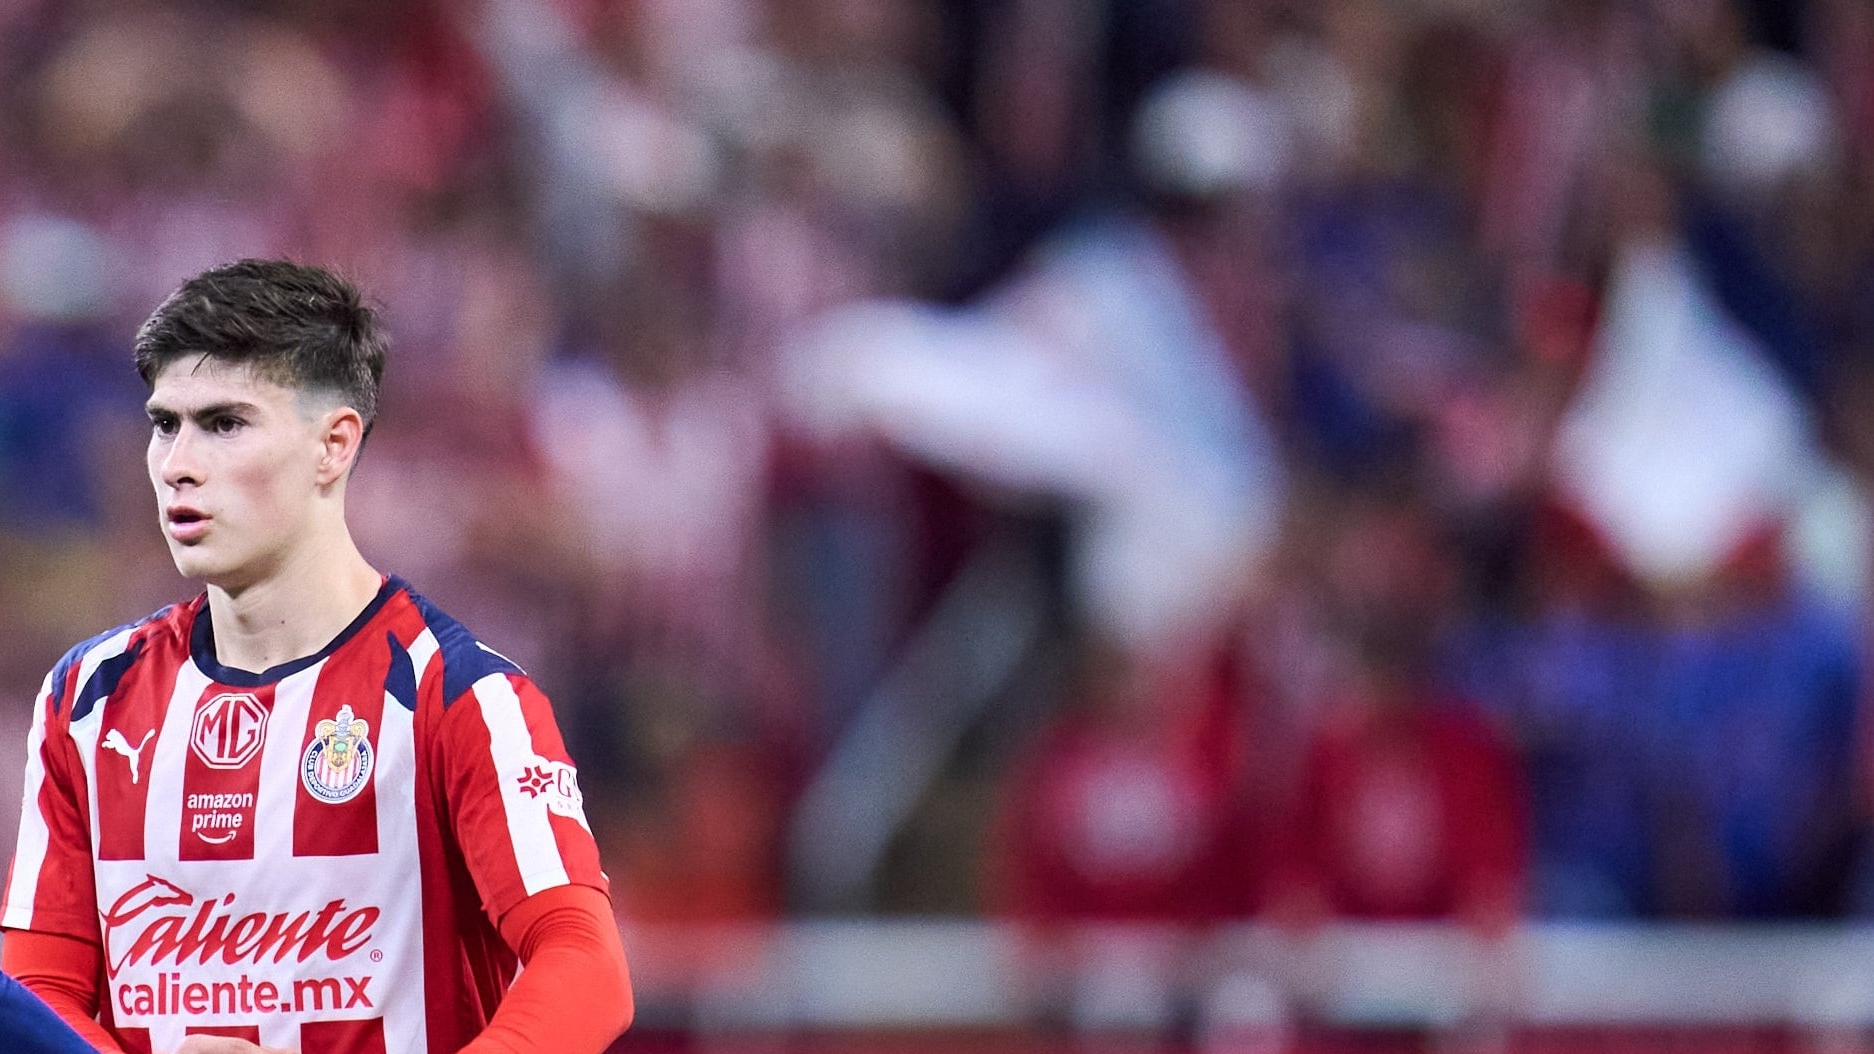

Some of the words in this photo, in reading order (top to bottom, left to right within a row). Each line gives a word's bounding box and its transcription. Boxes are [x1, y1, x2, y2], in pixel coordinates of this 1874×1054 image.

[197, 697, 261, 760] MG
[187, 792, 254, 809] amazon
[192, 809, 243, 833] prime
[98, 874, 381, 981] Caliente
[118, 971, 374, 1016] caliente.mx
